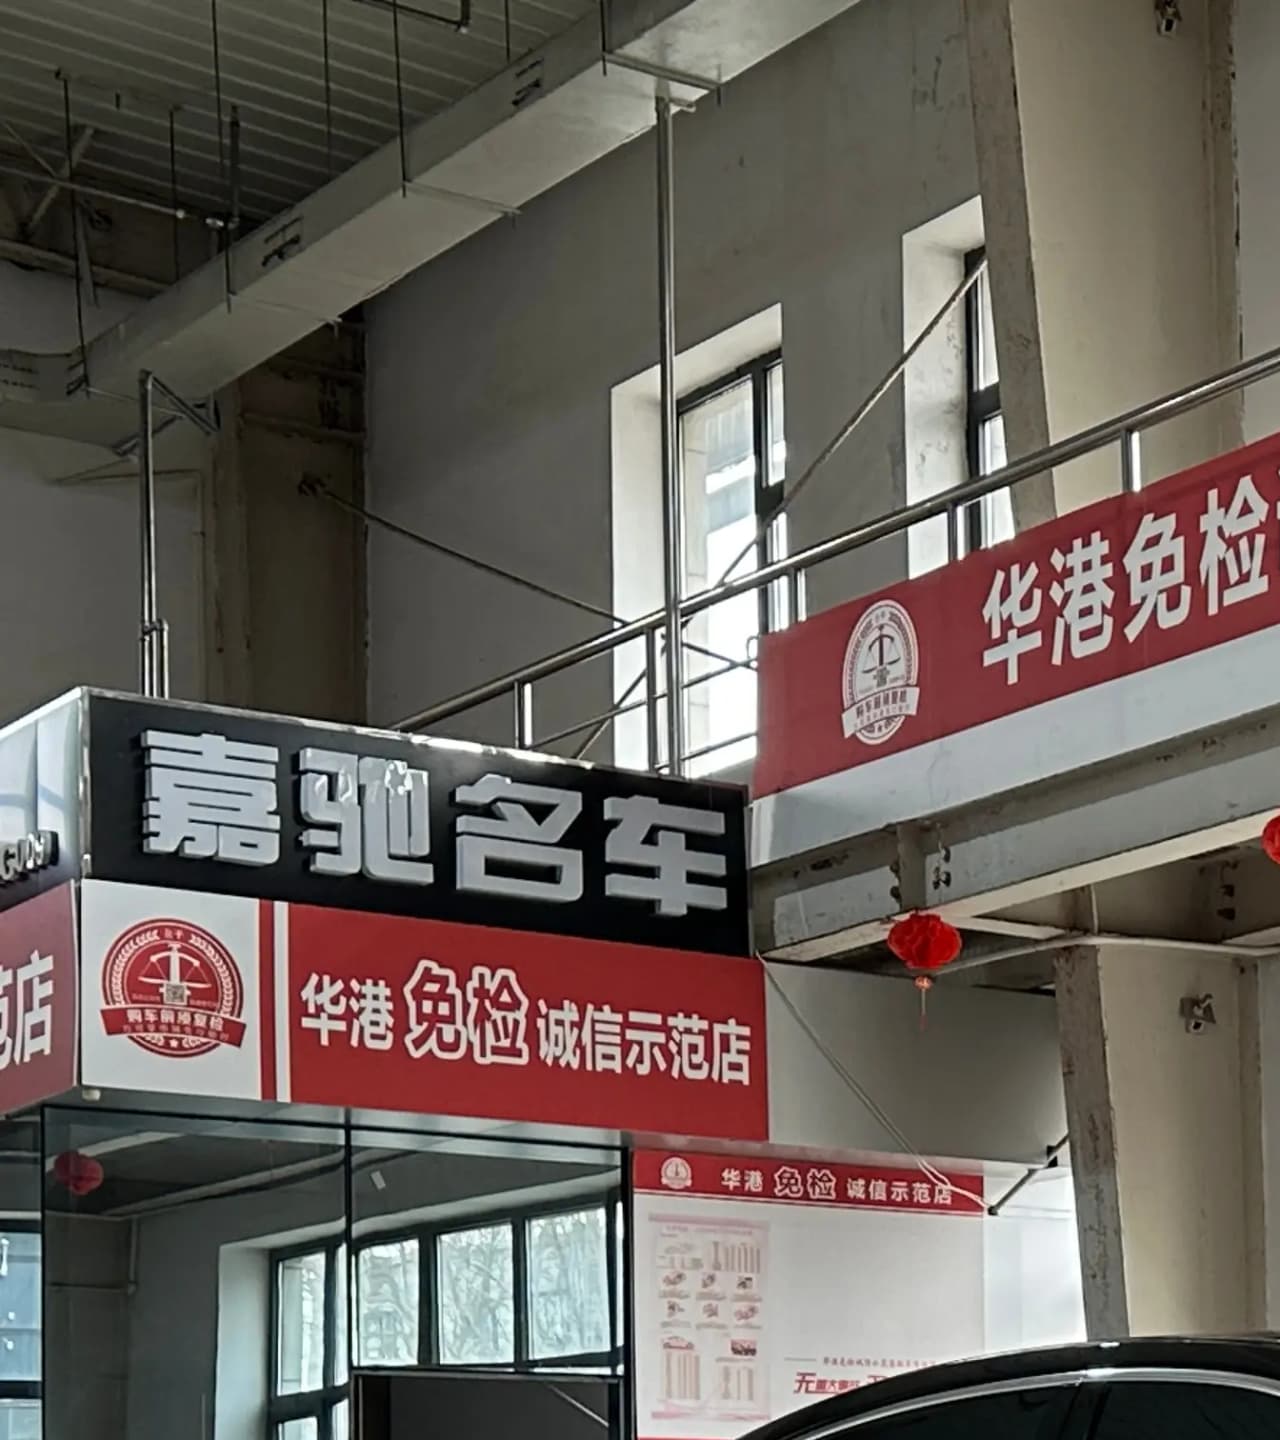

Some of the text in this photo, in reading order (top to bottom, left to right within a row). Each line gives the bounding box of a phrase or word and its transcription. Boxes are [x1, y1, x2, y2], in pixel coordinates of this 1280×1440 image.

[140, 728, 728, 918] 嘉驰名车
[300, 958, 751, 1086] 华港免检诚信示范店
